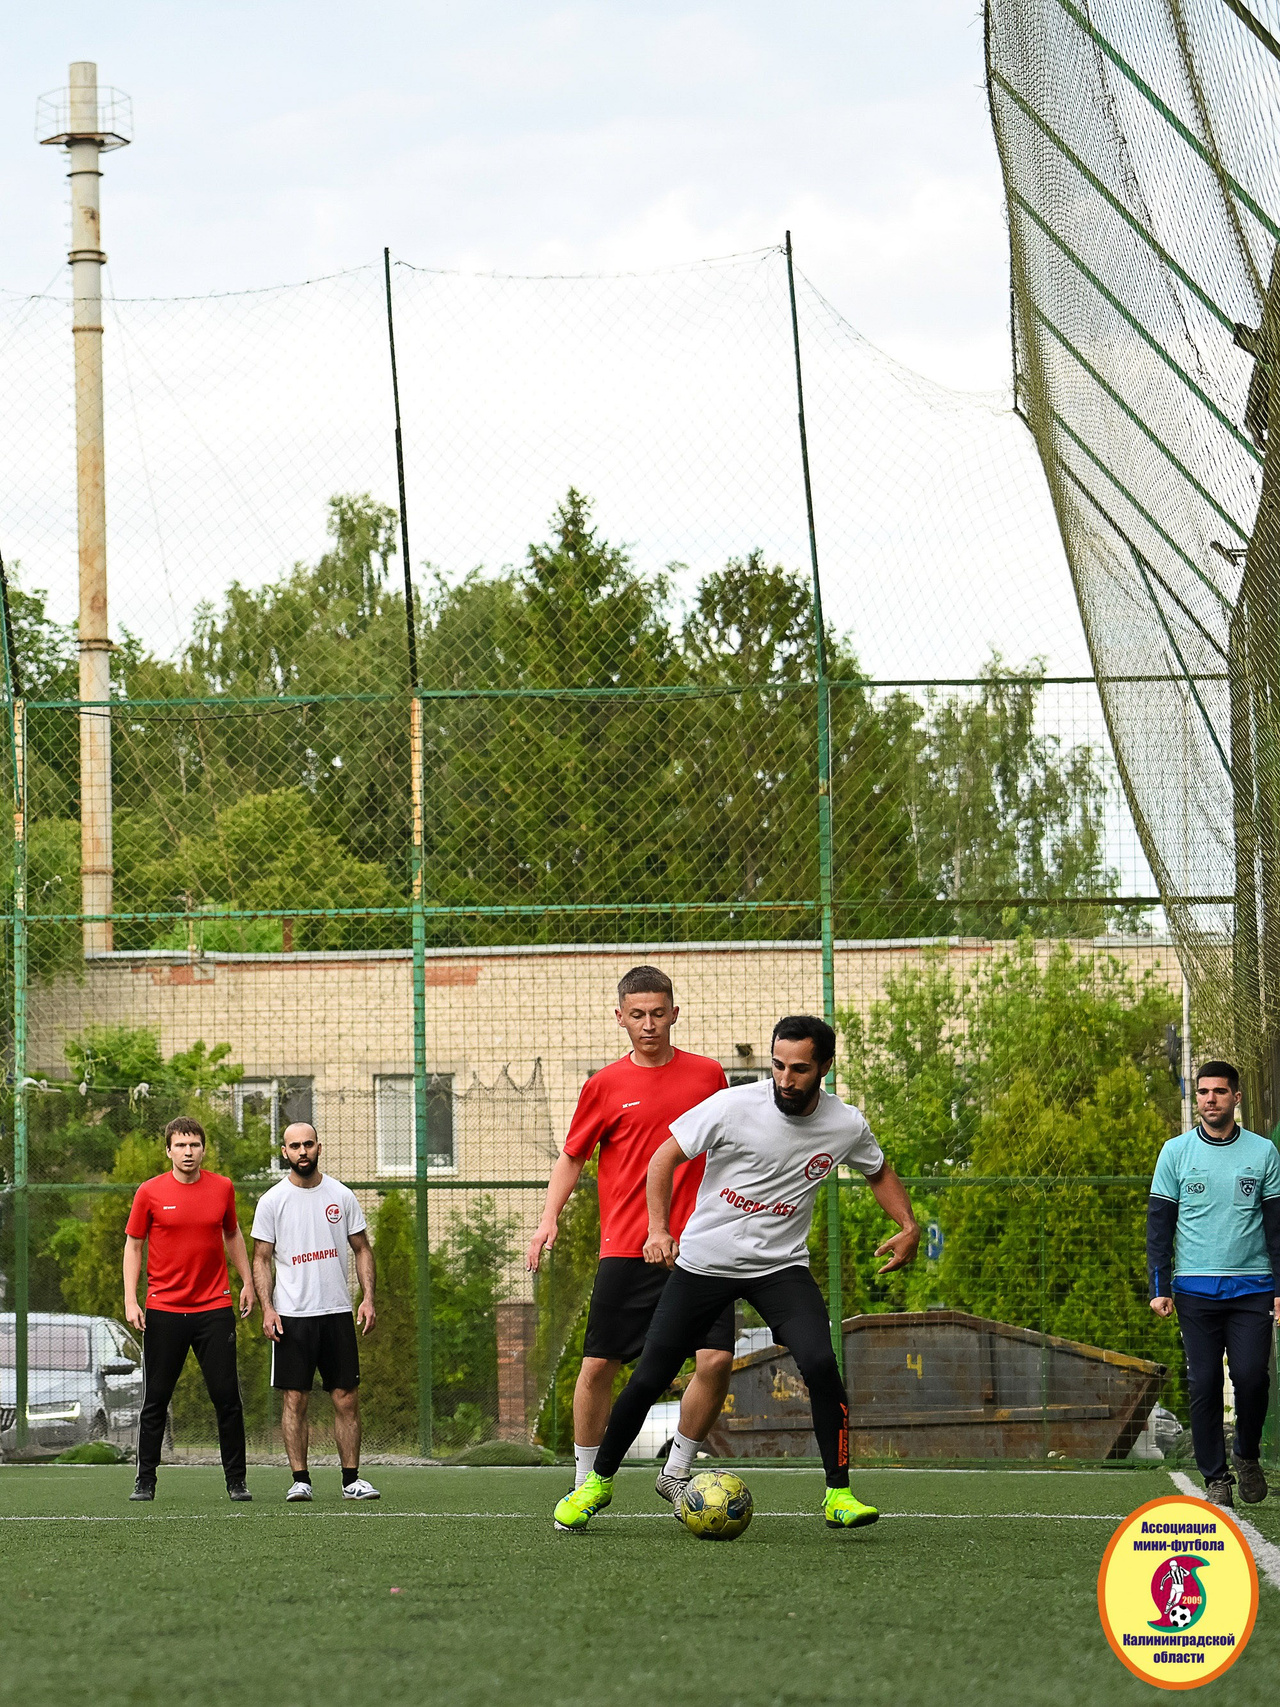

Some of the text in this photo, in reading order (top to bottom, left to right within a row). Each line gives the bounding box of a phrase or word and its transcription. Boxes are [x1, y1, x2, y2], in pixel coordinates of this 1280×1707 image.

[719, 1187, 798, 1218] РОССМКЕТ
[291, 1248, 339, 1266] РОССМАРКЕ
[906, 1353, 923, 1380] 4
